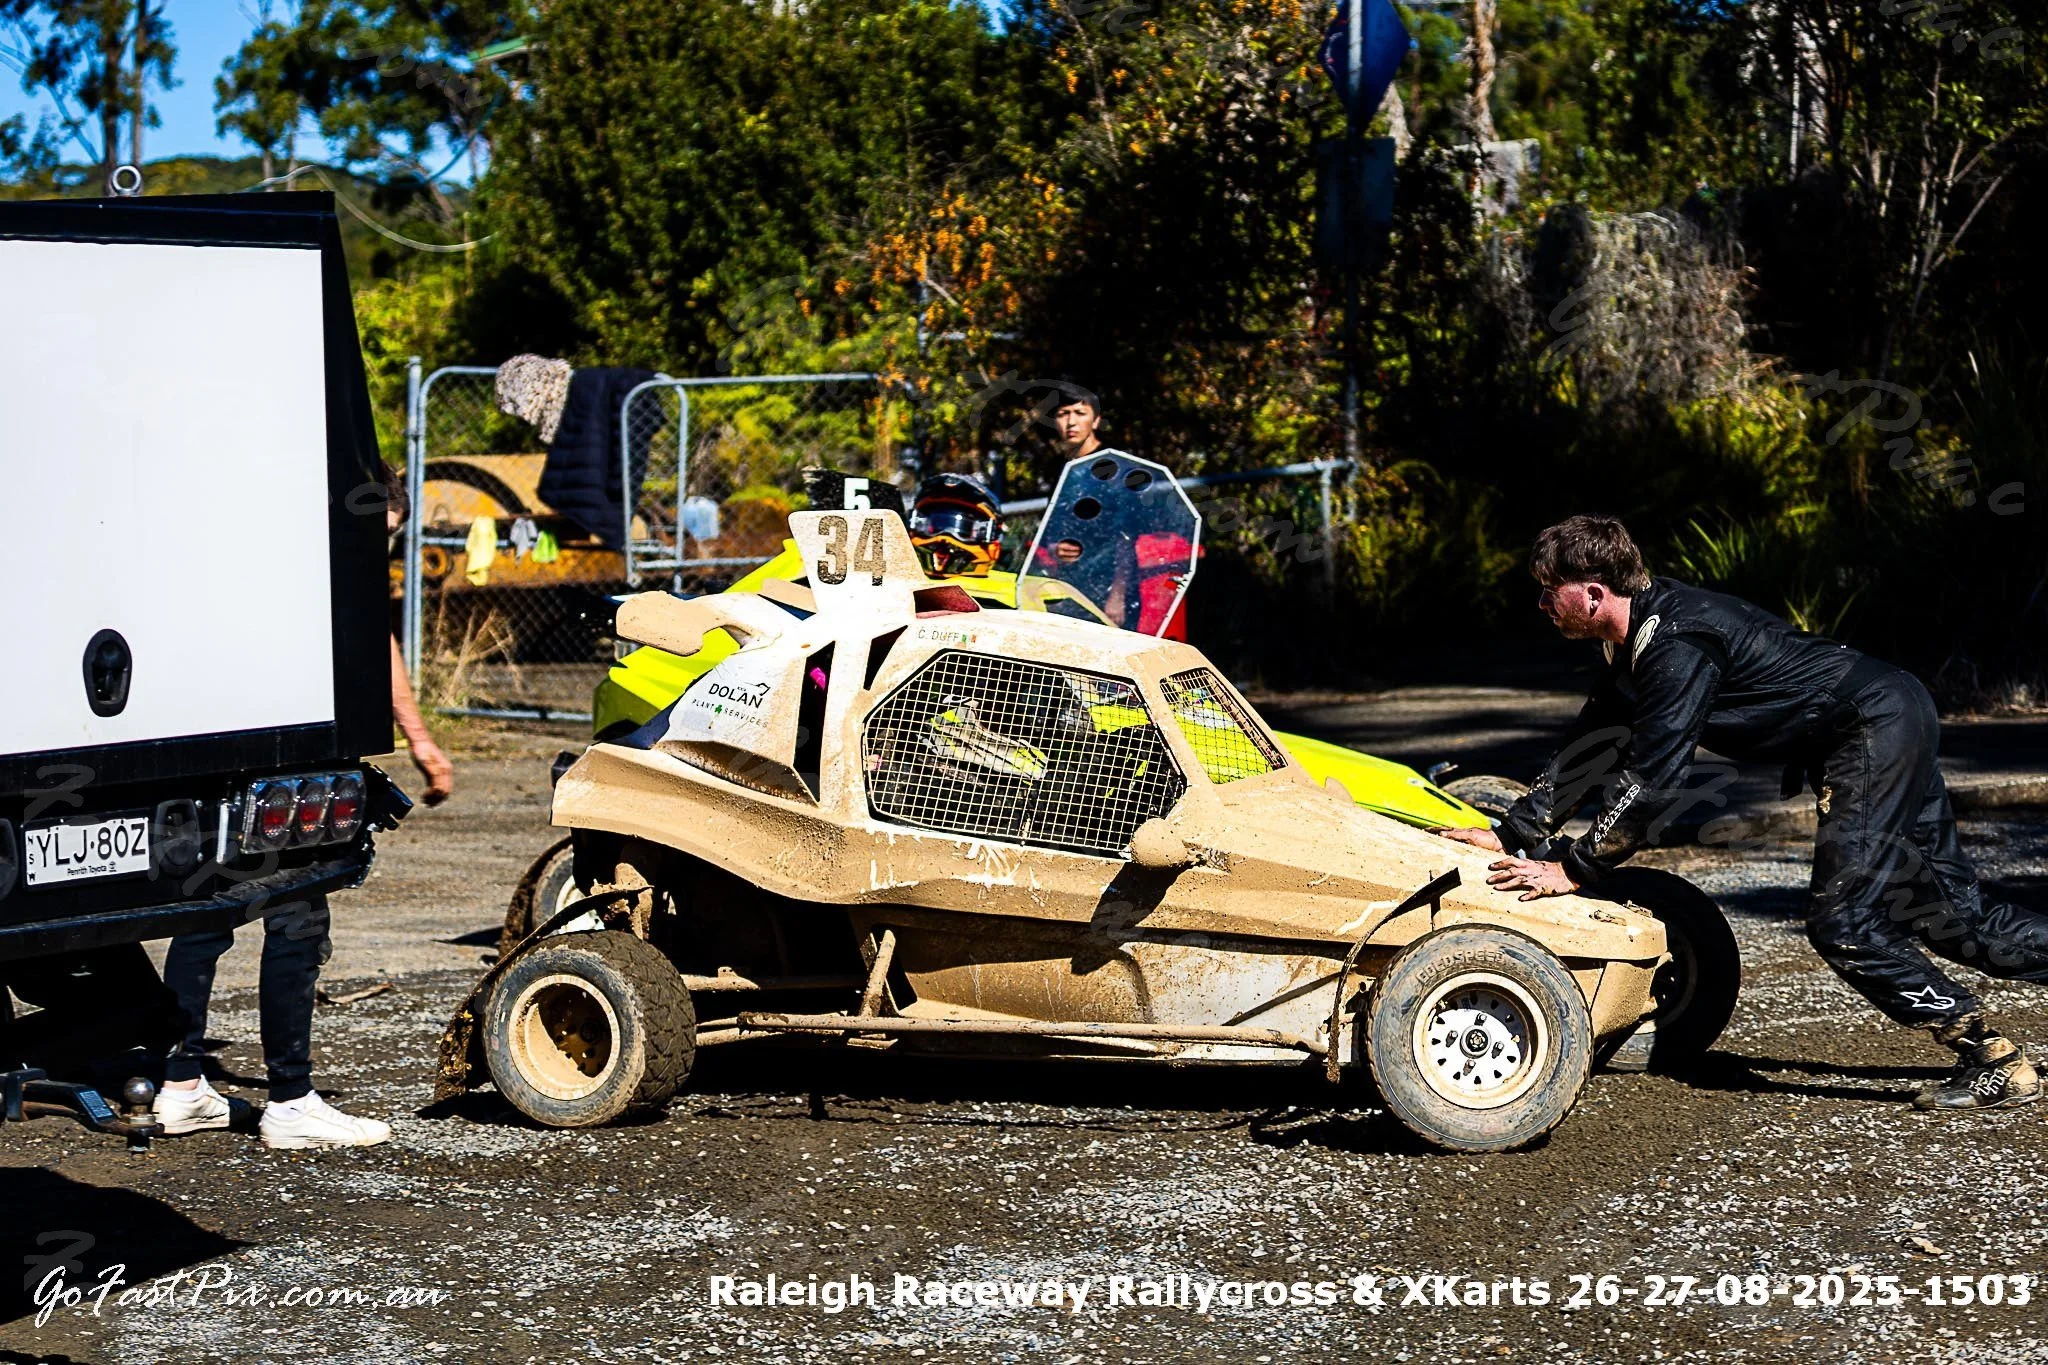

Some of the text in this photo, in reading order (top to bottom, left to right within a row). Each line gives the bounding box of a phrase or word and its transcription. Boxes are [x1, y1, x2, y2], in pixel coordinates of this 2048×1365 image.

[844, 477, 871, 510] 5
[816, 515, 887, 587] 34
[932, 630, 959, 642] DUFF
[708, 683, 764, 709] DOLAN
[691, 698, 769, 729] PLANT SERVICES
[88, 864, 107, 874] Toyota
